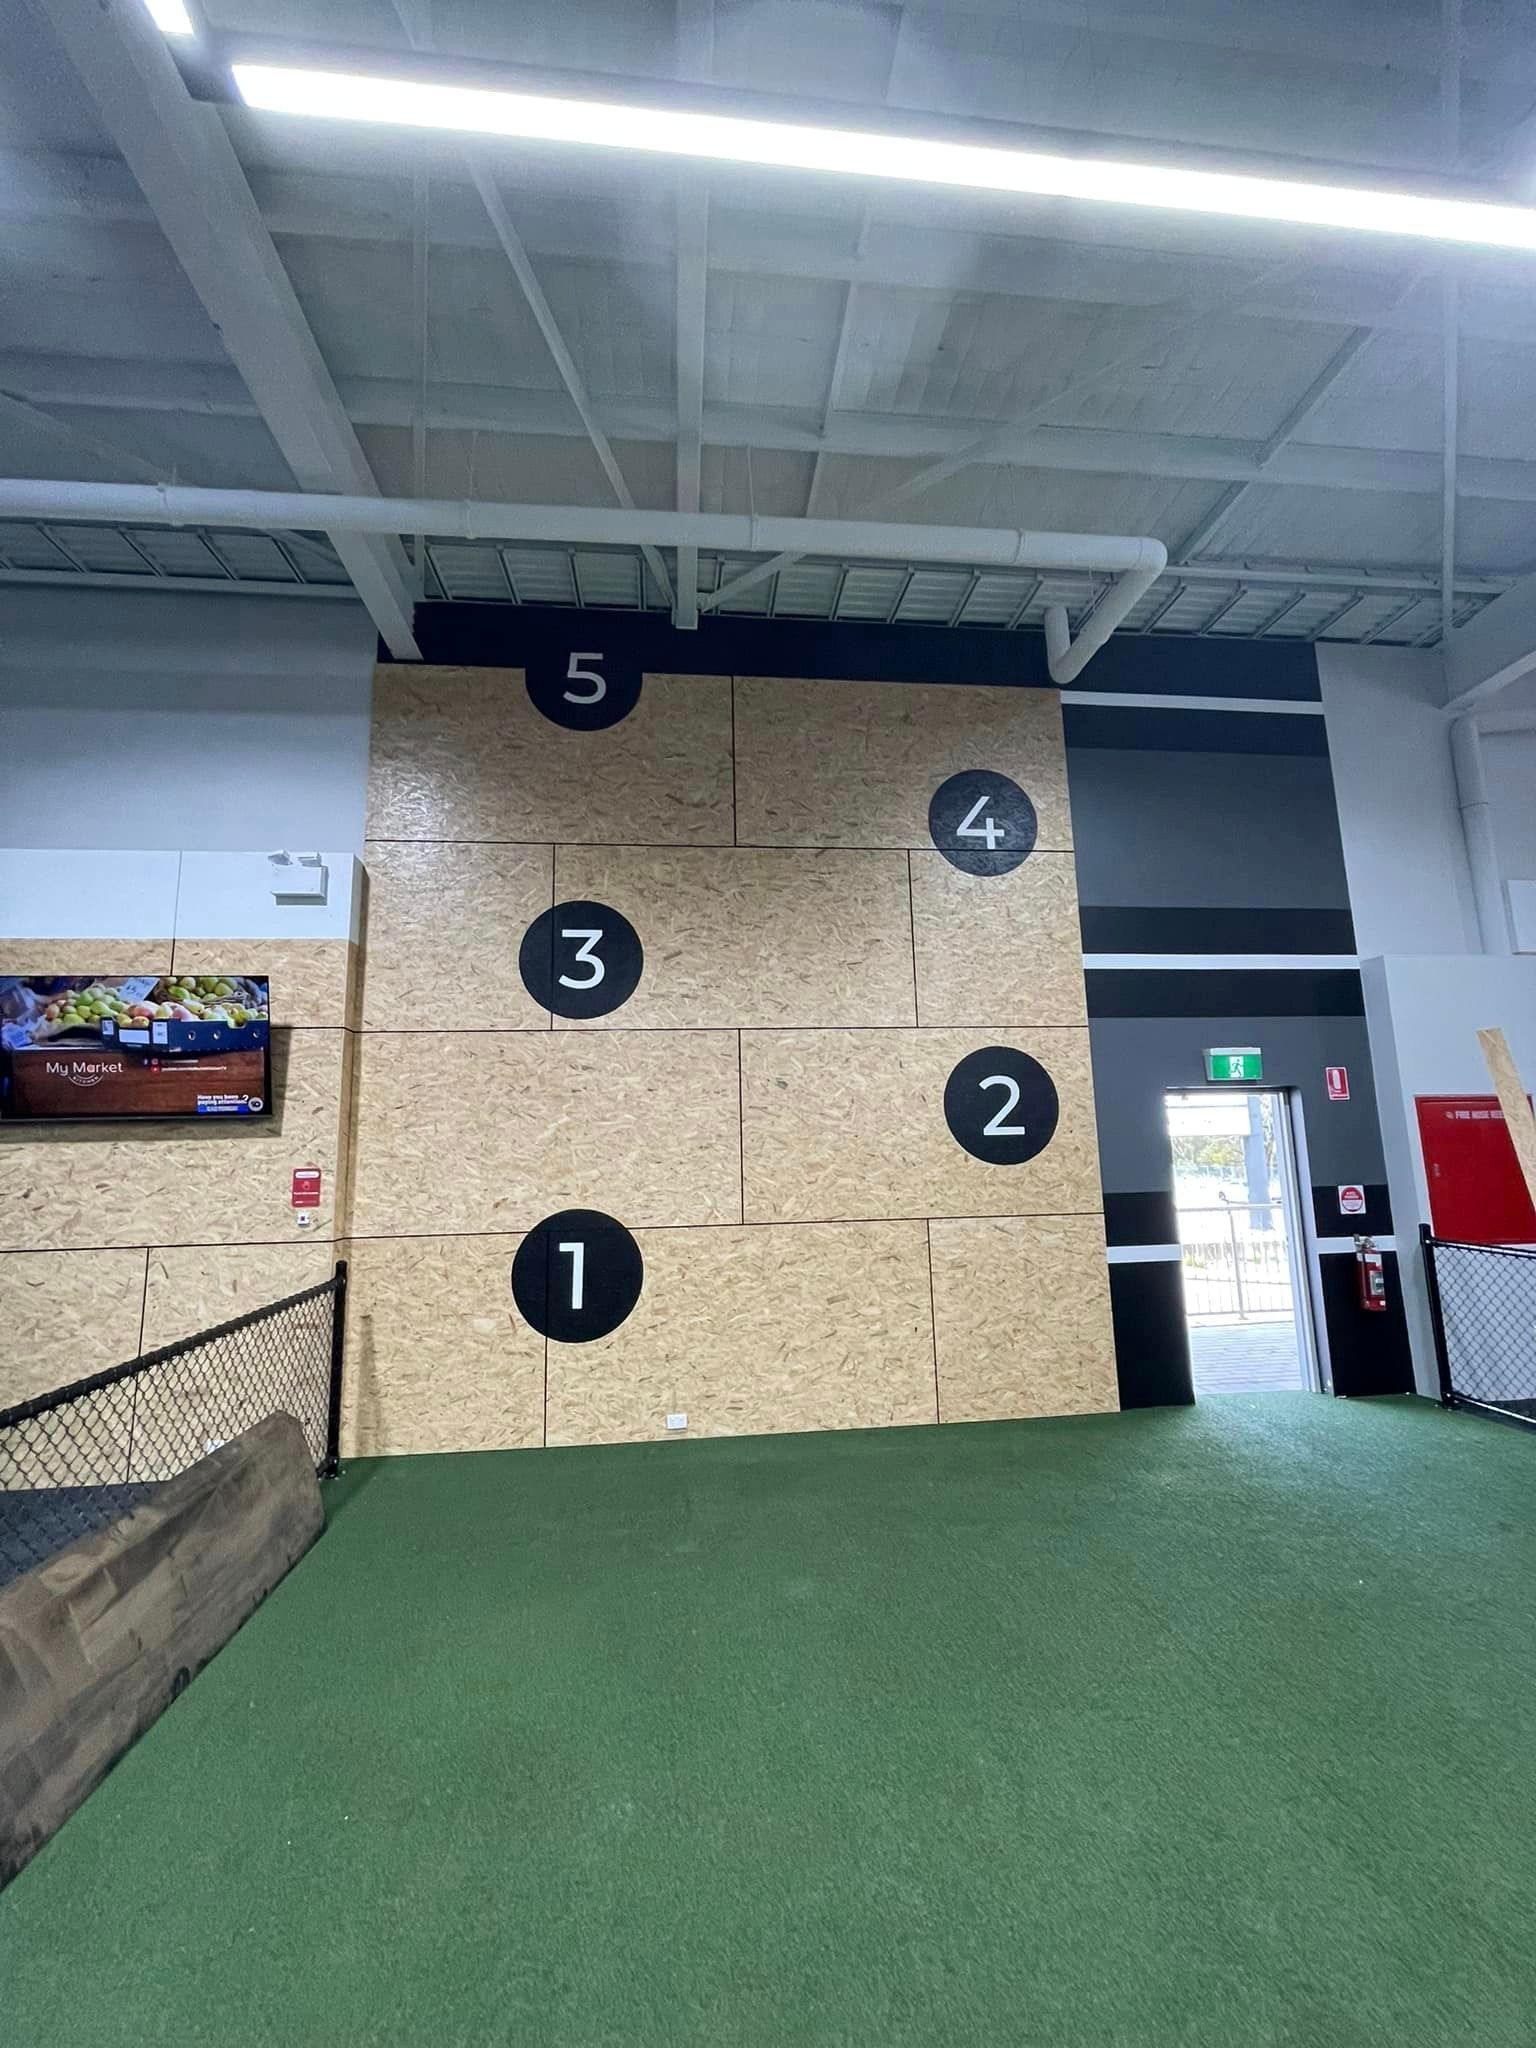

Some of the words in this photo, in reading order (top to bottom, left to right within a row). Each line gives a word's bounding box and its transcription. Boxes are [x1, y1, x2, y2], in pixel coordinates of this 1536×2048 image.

[563, 652, 607, 705] 5
[955, 796, 1006, 849] 4
[557, 929, 605, 990] 3
[46, 1061, 68, 1076] My
[73, 1061, 124, 1073] Market
[979, 1075, 1026, 1136] 2
[558, 1242, 584, 1310] 1
